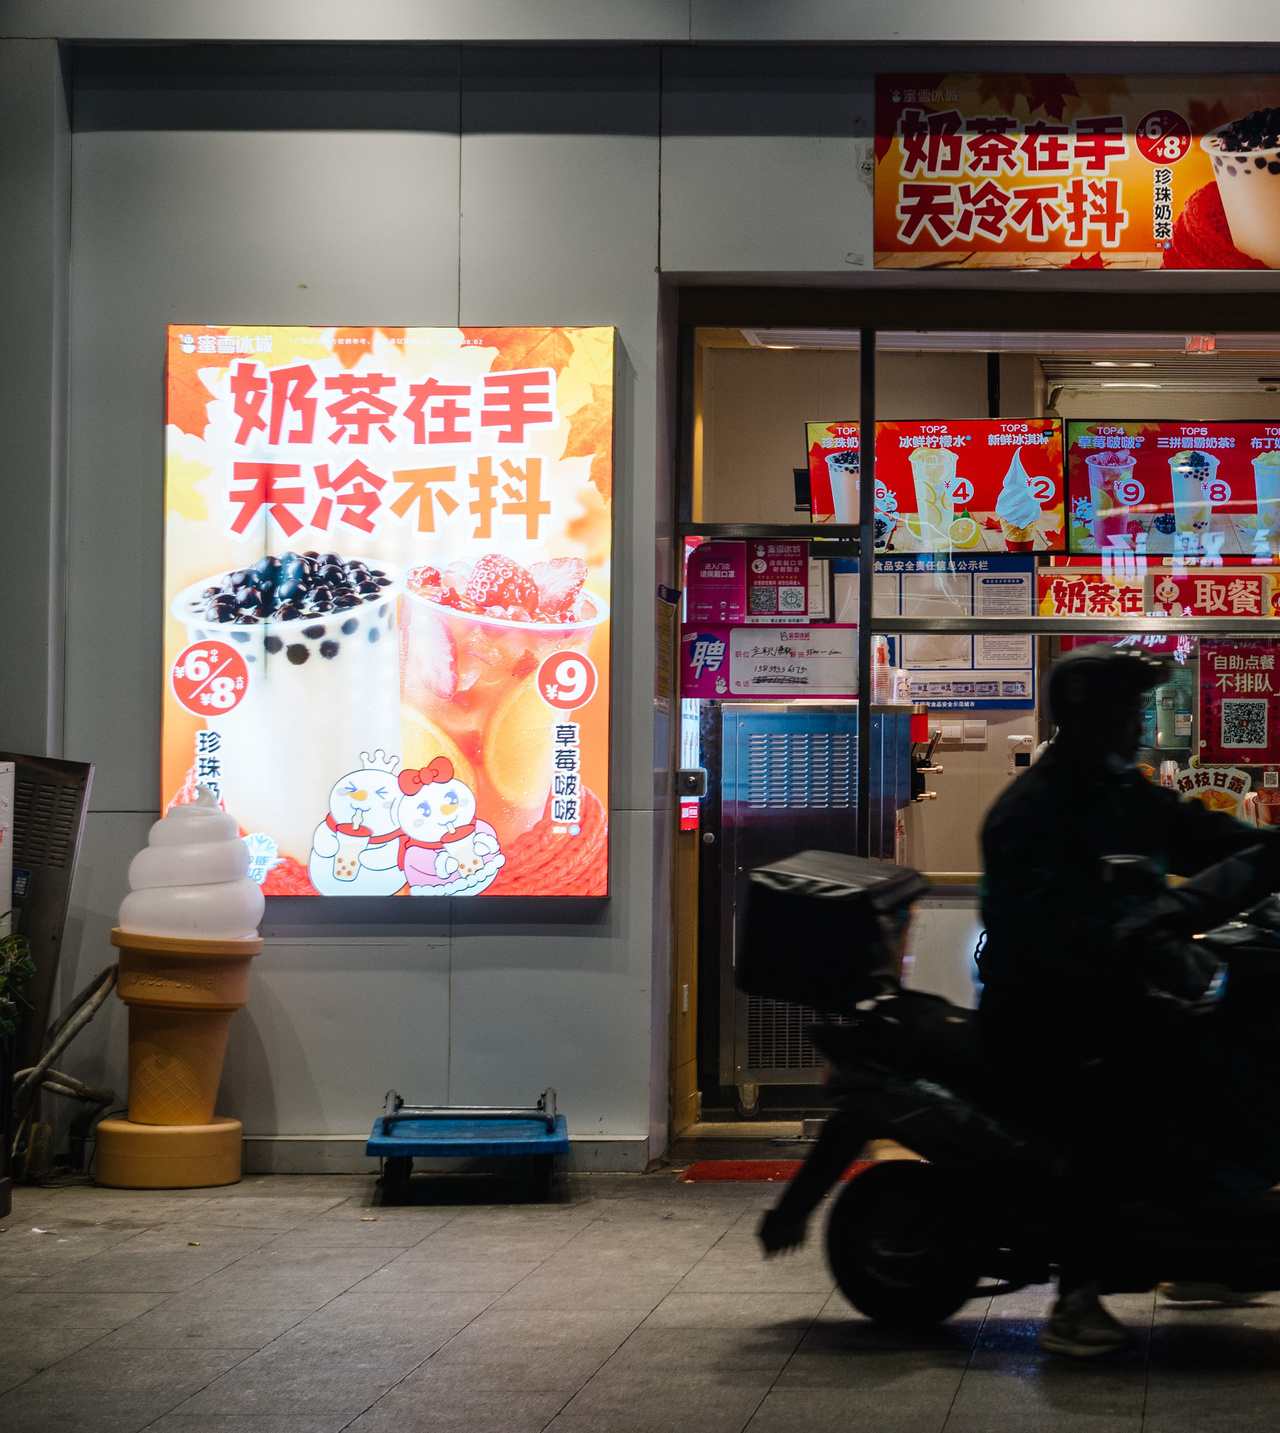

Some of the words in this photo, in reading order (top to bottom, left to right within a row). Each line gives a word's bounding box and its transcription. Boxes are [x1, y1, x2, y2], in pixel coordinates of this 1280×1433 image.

[900, 109, 1126, 173] 奶茶在手
[900, 179, 1125, 242] 天冷不抖
[1154, 168, 1172, 239] 珍珠奶茶
[197, 335, 273, 354] 蜜雪冰城
[230, 362, 553, 447] 奶茶在手
[920, 425, 948, 434] TOP2
[1000, 424, 1028, 433] TOP3
[1096, 426, 1125, 435] TOP4
[1180, 427, 1208, 435] TOP5
[821, 437, 859, 449] 珍珠奶
[899, 435, 966, 448] 冰鲜柠檬水
[987, 433, 1050, 446] 新鲜冰淇淋
[1077, 435, 1136, 449] 草莓啵啵
[1156, 437, 1230, 449] 三拼霸霸奶茶
[228, 456, 552, 541] 天冷不抖
[873, 560, 989, 572] 食品安全责任信息公示栏
[1193, 578, 1261, 614] 取餐
[690, 640, 727, 680] 聘
[554, 724, 577, 821] 草莓啵啵
[1176, 770, 1246, 796] 杨枝甘露
